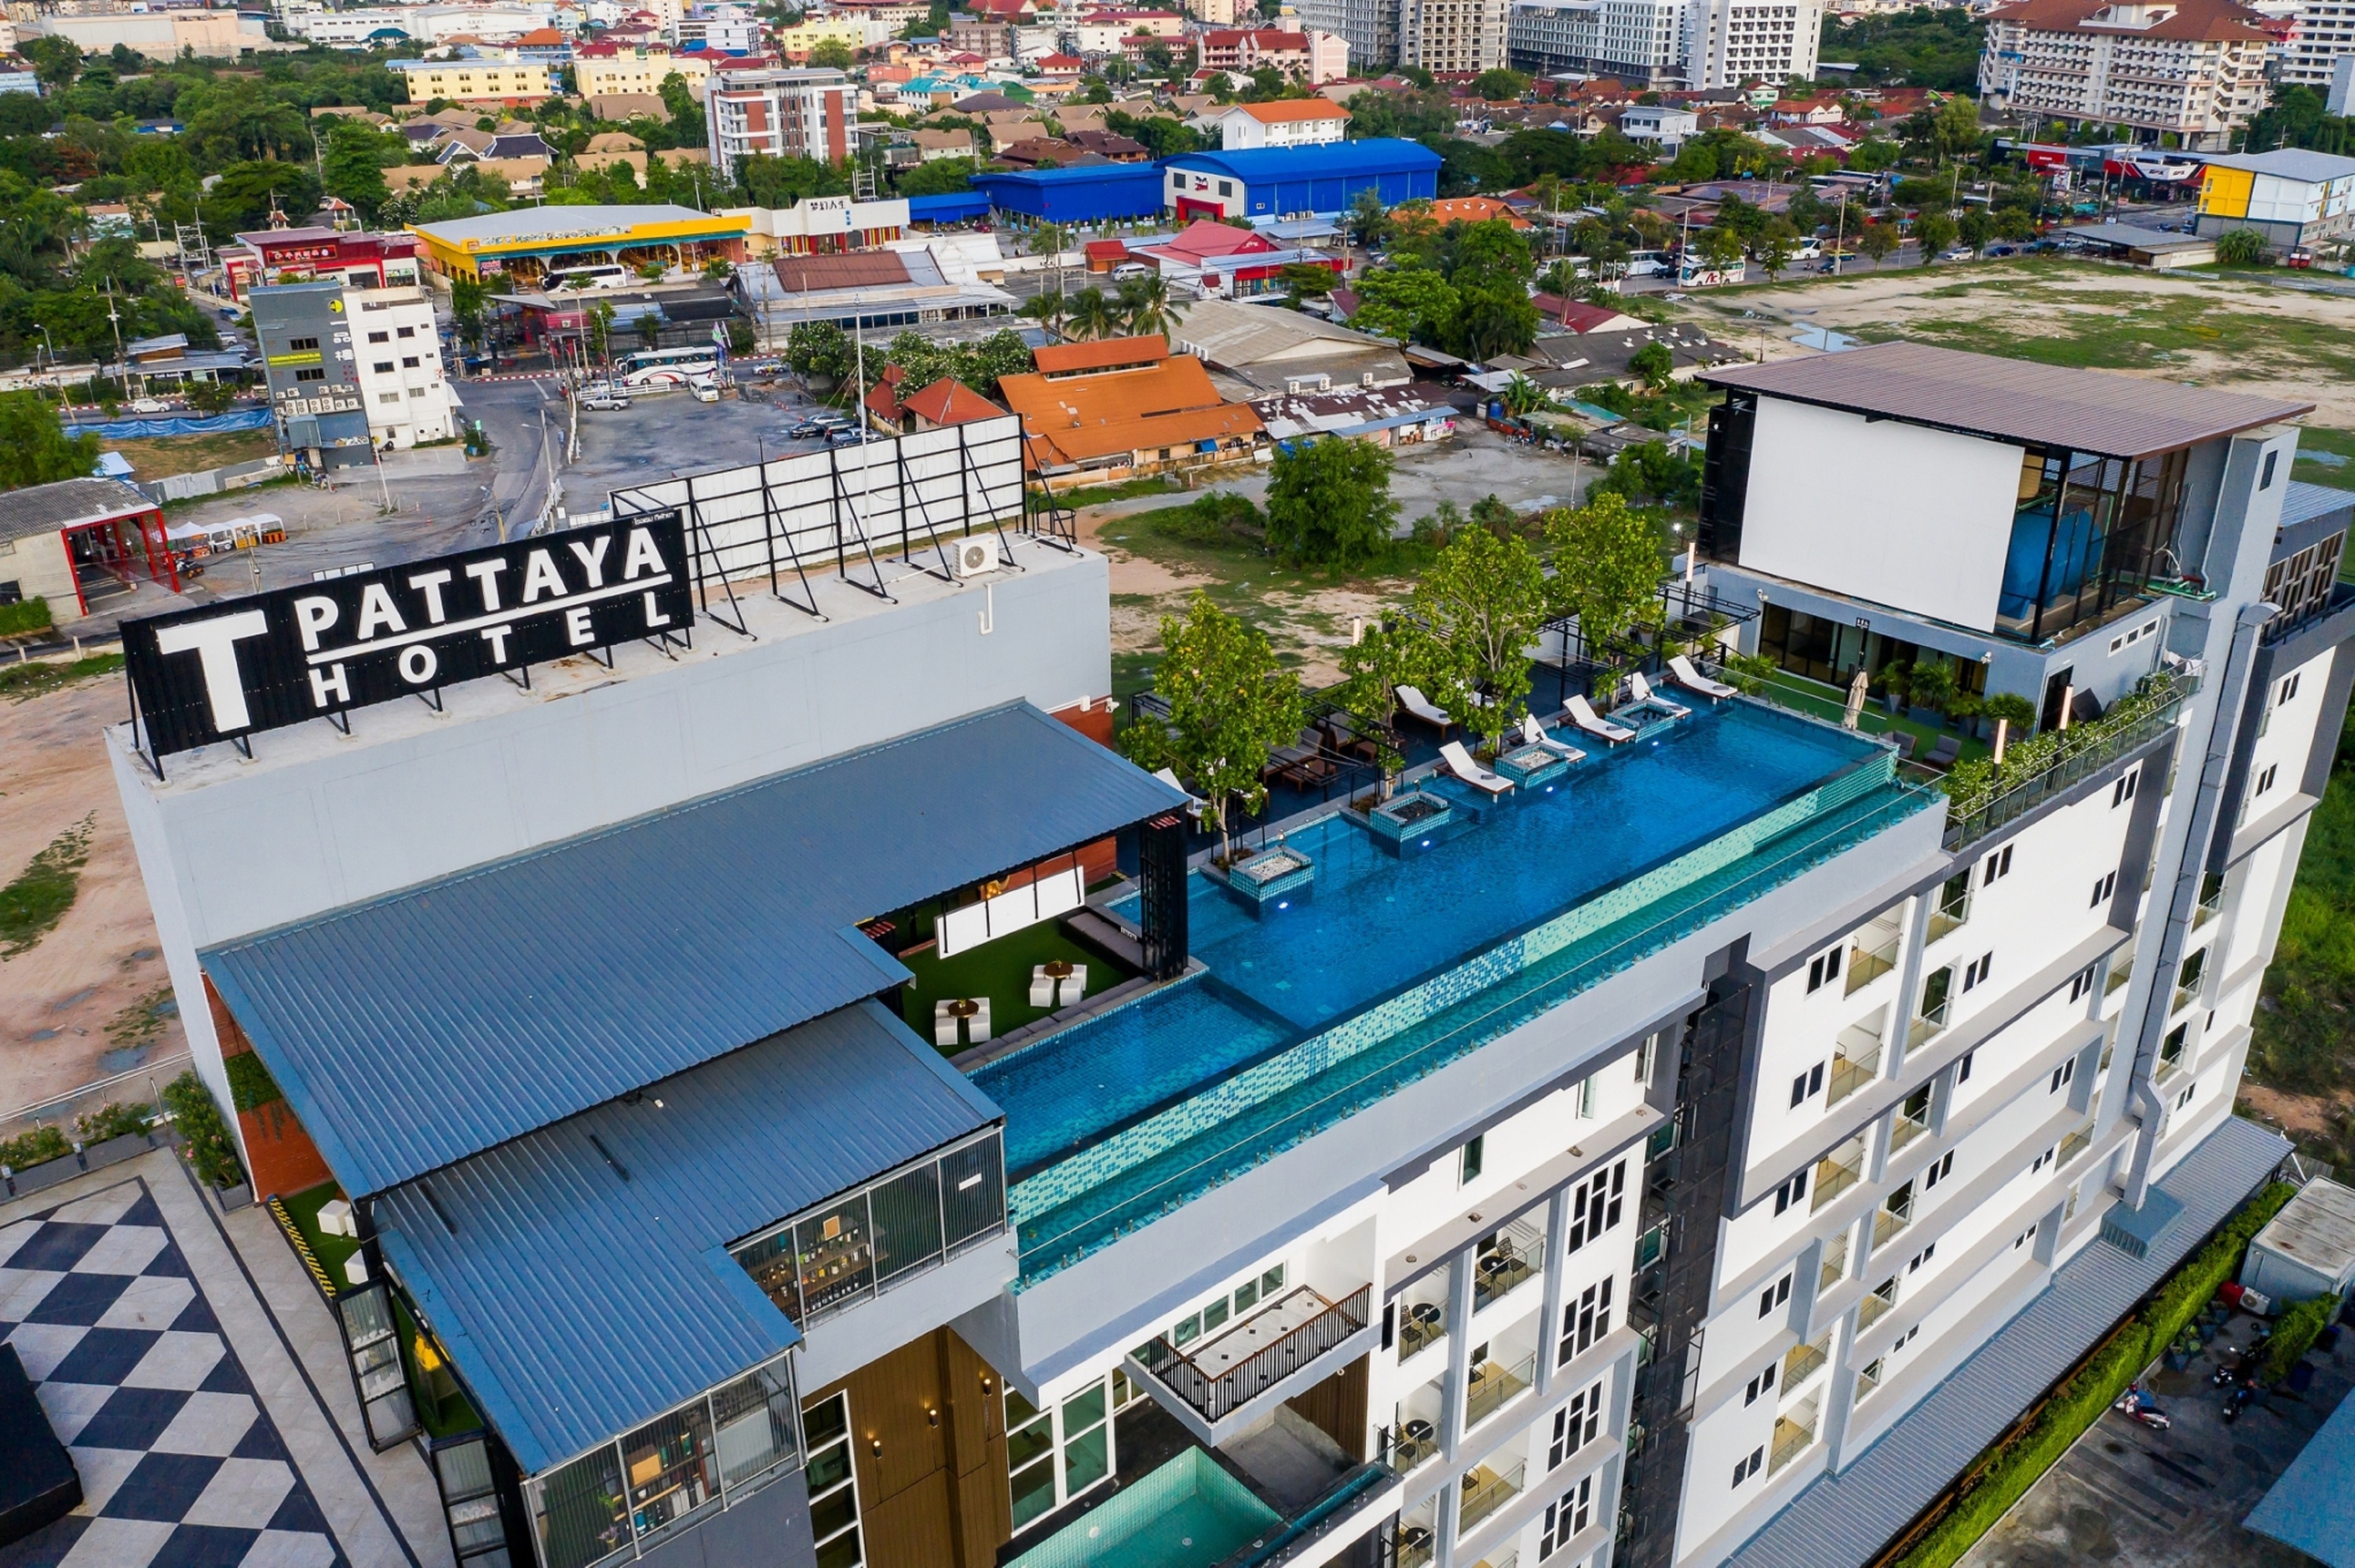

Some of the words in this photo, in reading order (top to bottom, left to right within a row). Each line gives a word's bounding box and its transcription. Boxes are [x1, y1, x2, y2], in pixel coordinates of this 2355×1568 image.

[294, 527, 668, 652] PATTAYA
[308, 591, 671, 708] HOTEL
[155, 610, 269, 734] T
